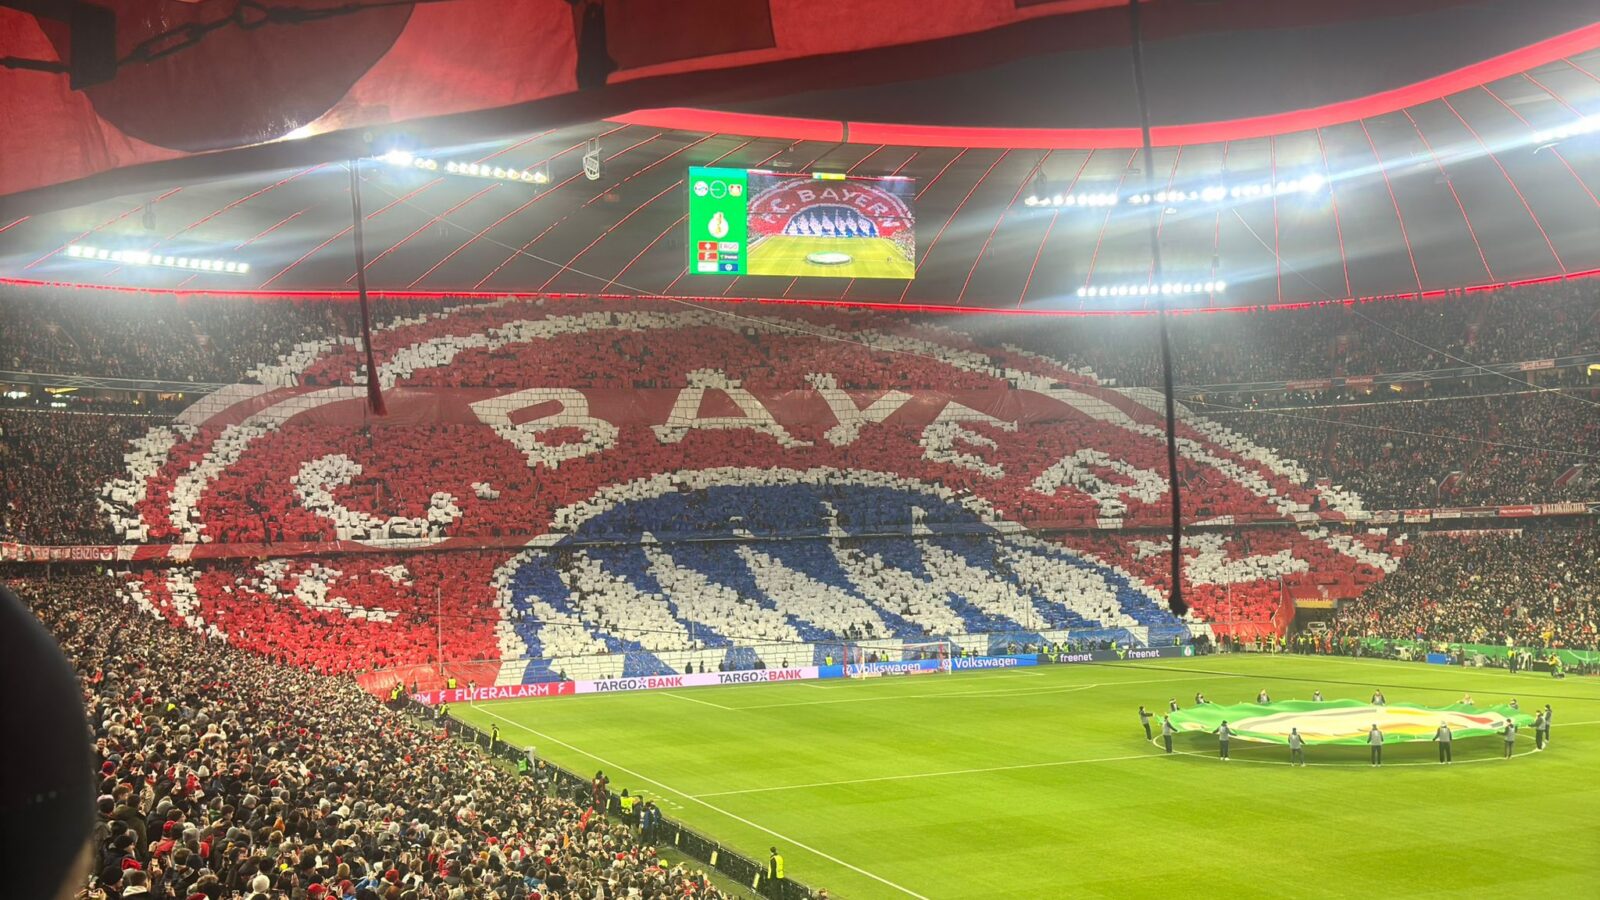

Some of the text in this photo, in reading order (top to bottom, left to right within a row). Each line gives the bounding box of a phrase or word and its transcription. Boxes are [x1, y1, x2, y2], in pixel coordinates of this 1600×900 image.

[470, 366, 1311, 588] BAYERN
[71, 547, 100, 561] SENZIG
[1060, 652, 1093, 663] freenet
[1128, 648, 1160, 659] freenet
[854, 662, 921, 676] Volkswagen
[953, 655, 1018, 670] Volkswagen
[455, 682, 549, 701] FLYERALARM
